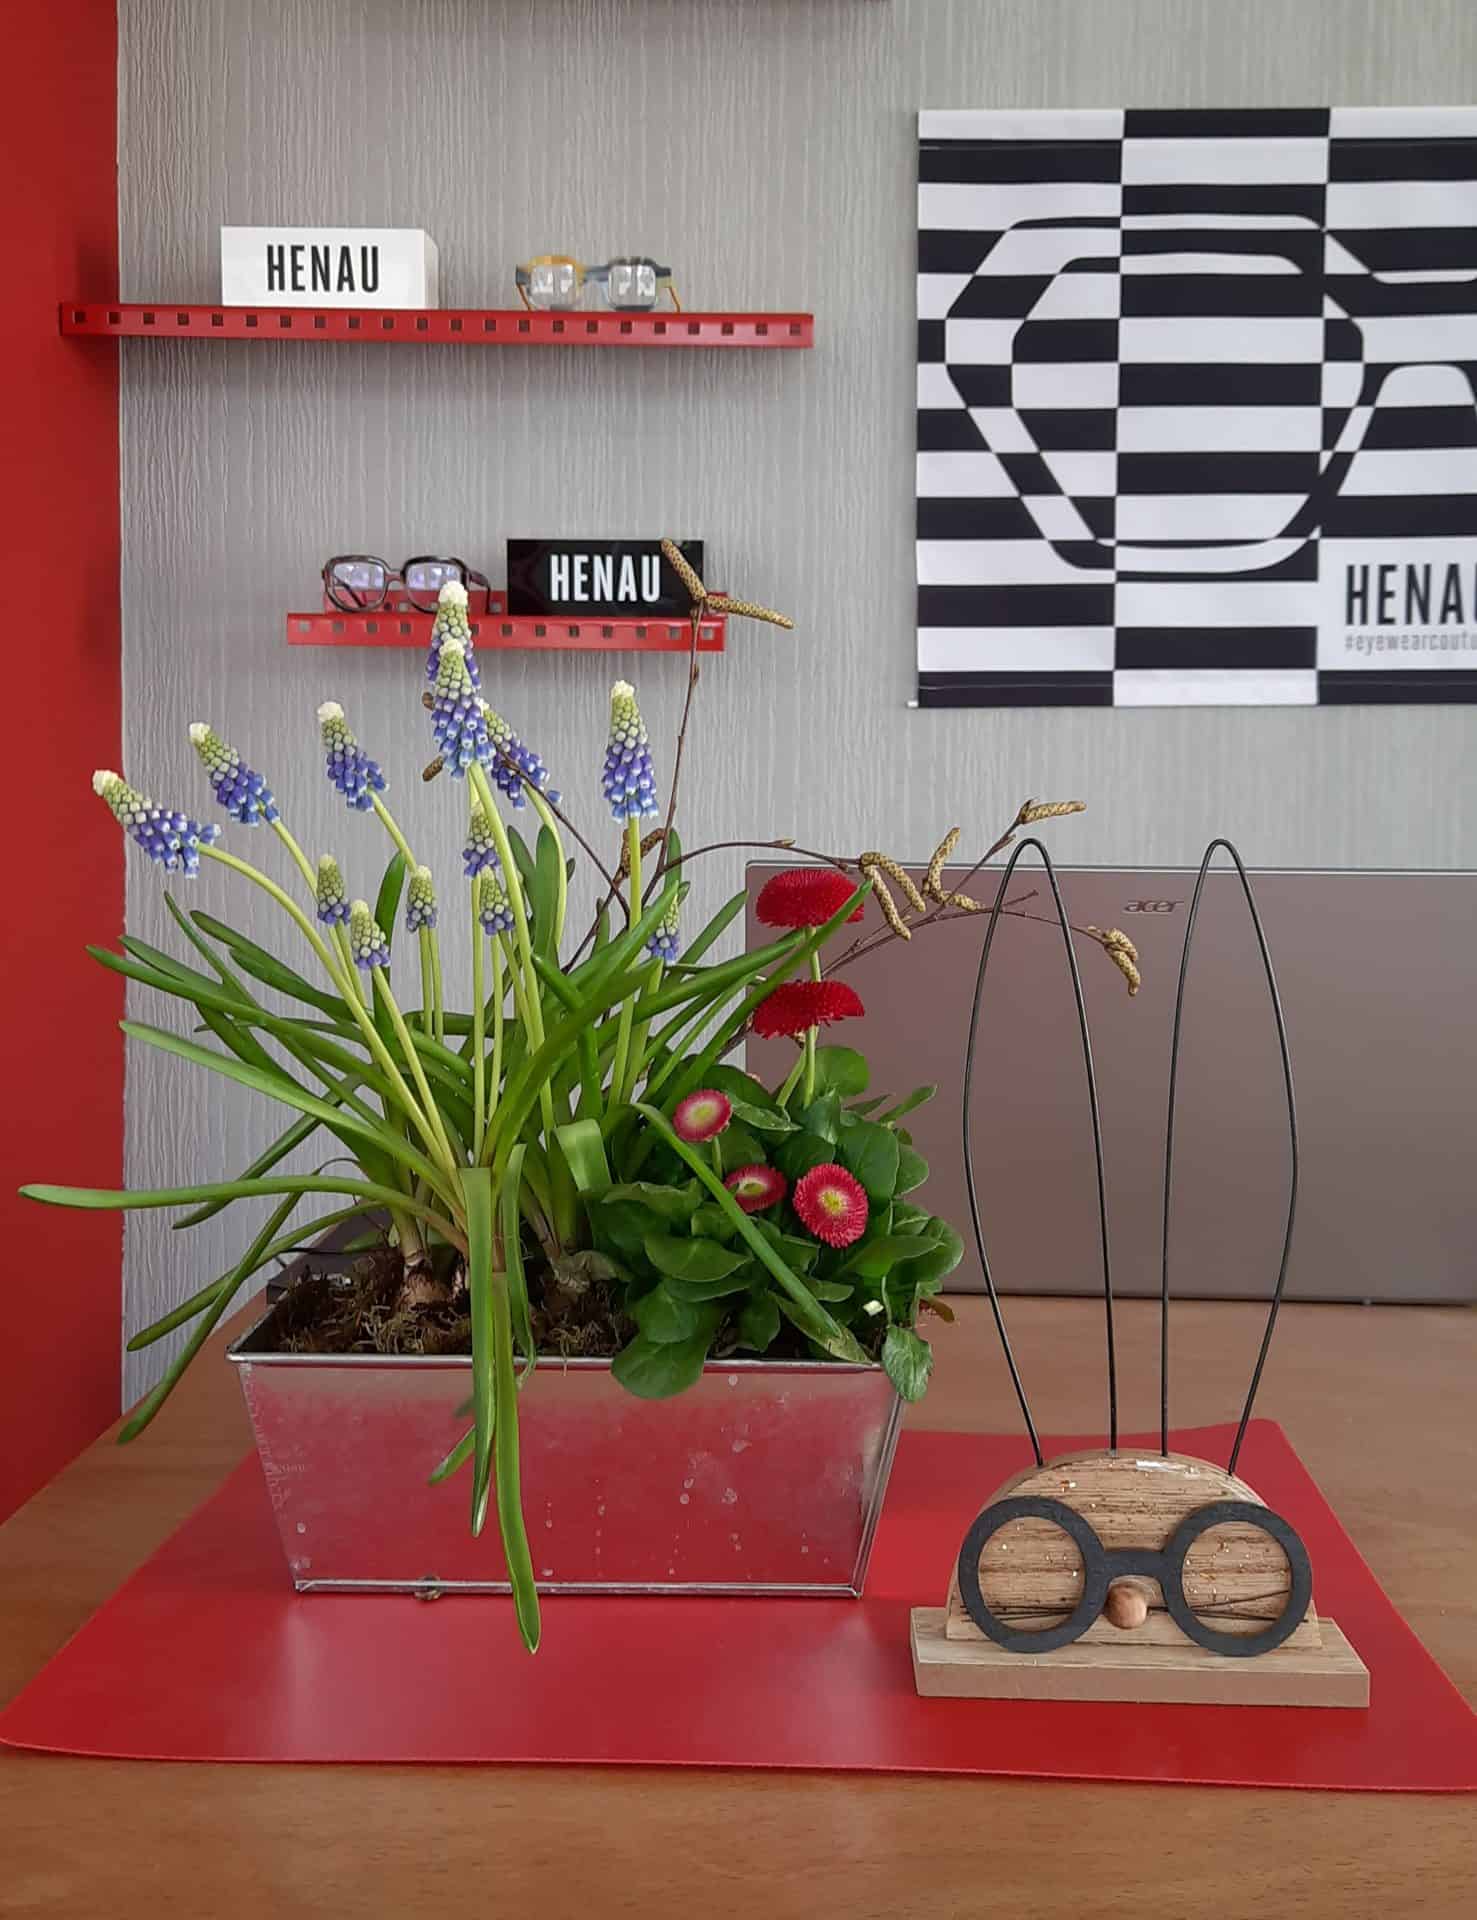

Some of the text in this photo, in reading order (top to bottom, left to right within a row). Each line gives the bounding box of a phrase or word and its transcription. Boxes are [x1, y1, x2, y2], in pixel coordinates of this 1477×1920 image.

[267, 245, 379, 293] HENAU
[551, 554, 660, 602] HENAU
[1346, 563, 1477, 625] HENA
[1124, 900, 1184, 912] acer
